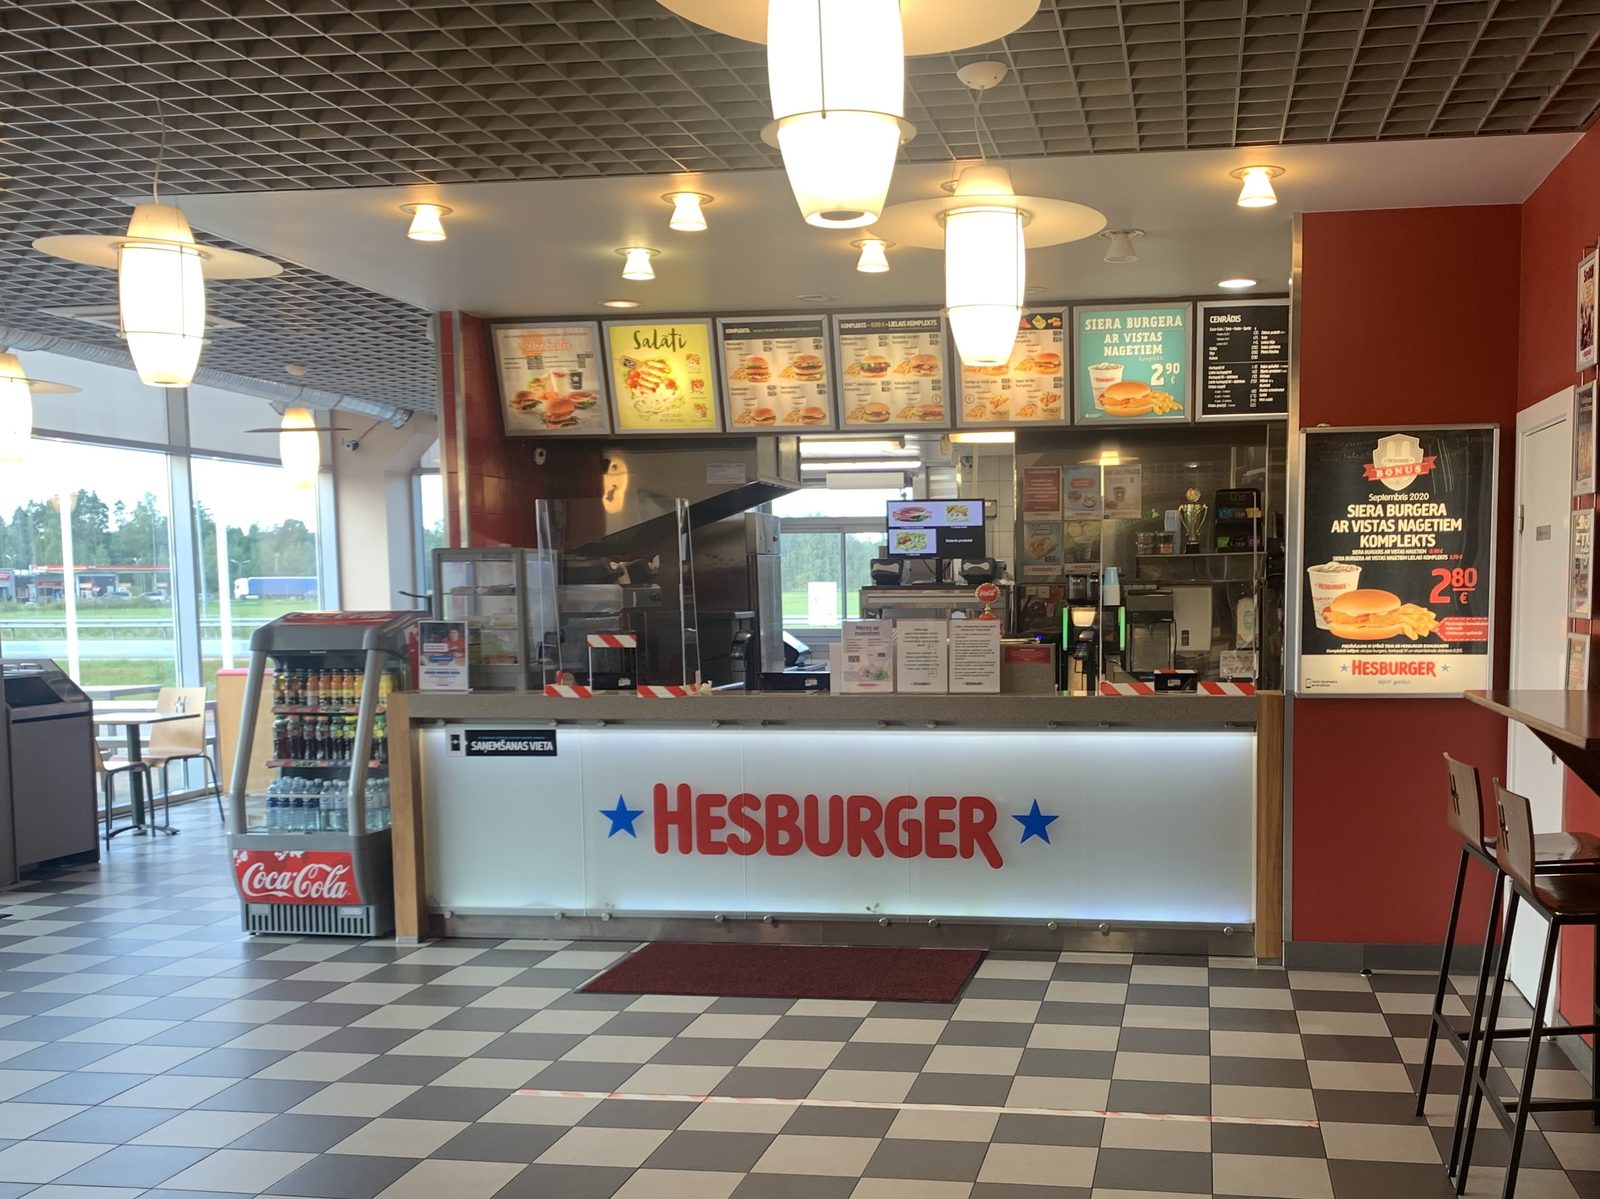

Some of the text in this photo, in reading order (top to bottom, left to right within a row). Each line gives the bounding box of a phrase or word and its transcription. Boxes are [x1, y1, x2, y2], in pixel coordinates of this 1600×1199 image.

[1085, 315, 1183, 331] SIERA BURGERA
[1209, 314, 1242, 323] CENRĀDIS
[633, 327, 688, 353] Salāti
[1104, 331, 1164, 344] AR VISTAS
[1103, 344, 1164, 357] NAGETIEM
[1376, 465, 1422, 478] BONUS
[1368, 492, 1430, 504] Septembris 2020
[1347, 502, 1448, 518] SIERA BURGERA
[1331, 518, 1463, 534] AR VISTAS NAGETIEM
[1360, 533, 1436, 548] KOMPLEKTS
[1459, 591, 1469, 605] €
[1351, 659, 1437, 678] HESBURGER
[471, 739, 554, 753] SAŅEMŠANAS VIETA
[653, 782, 1004, 870] HESBURGER
[242, 862, 351, 899] Coca-Cola
